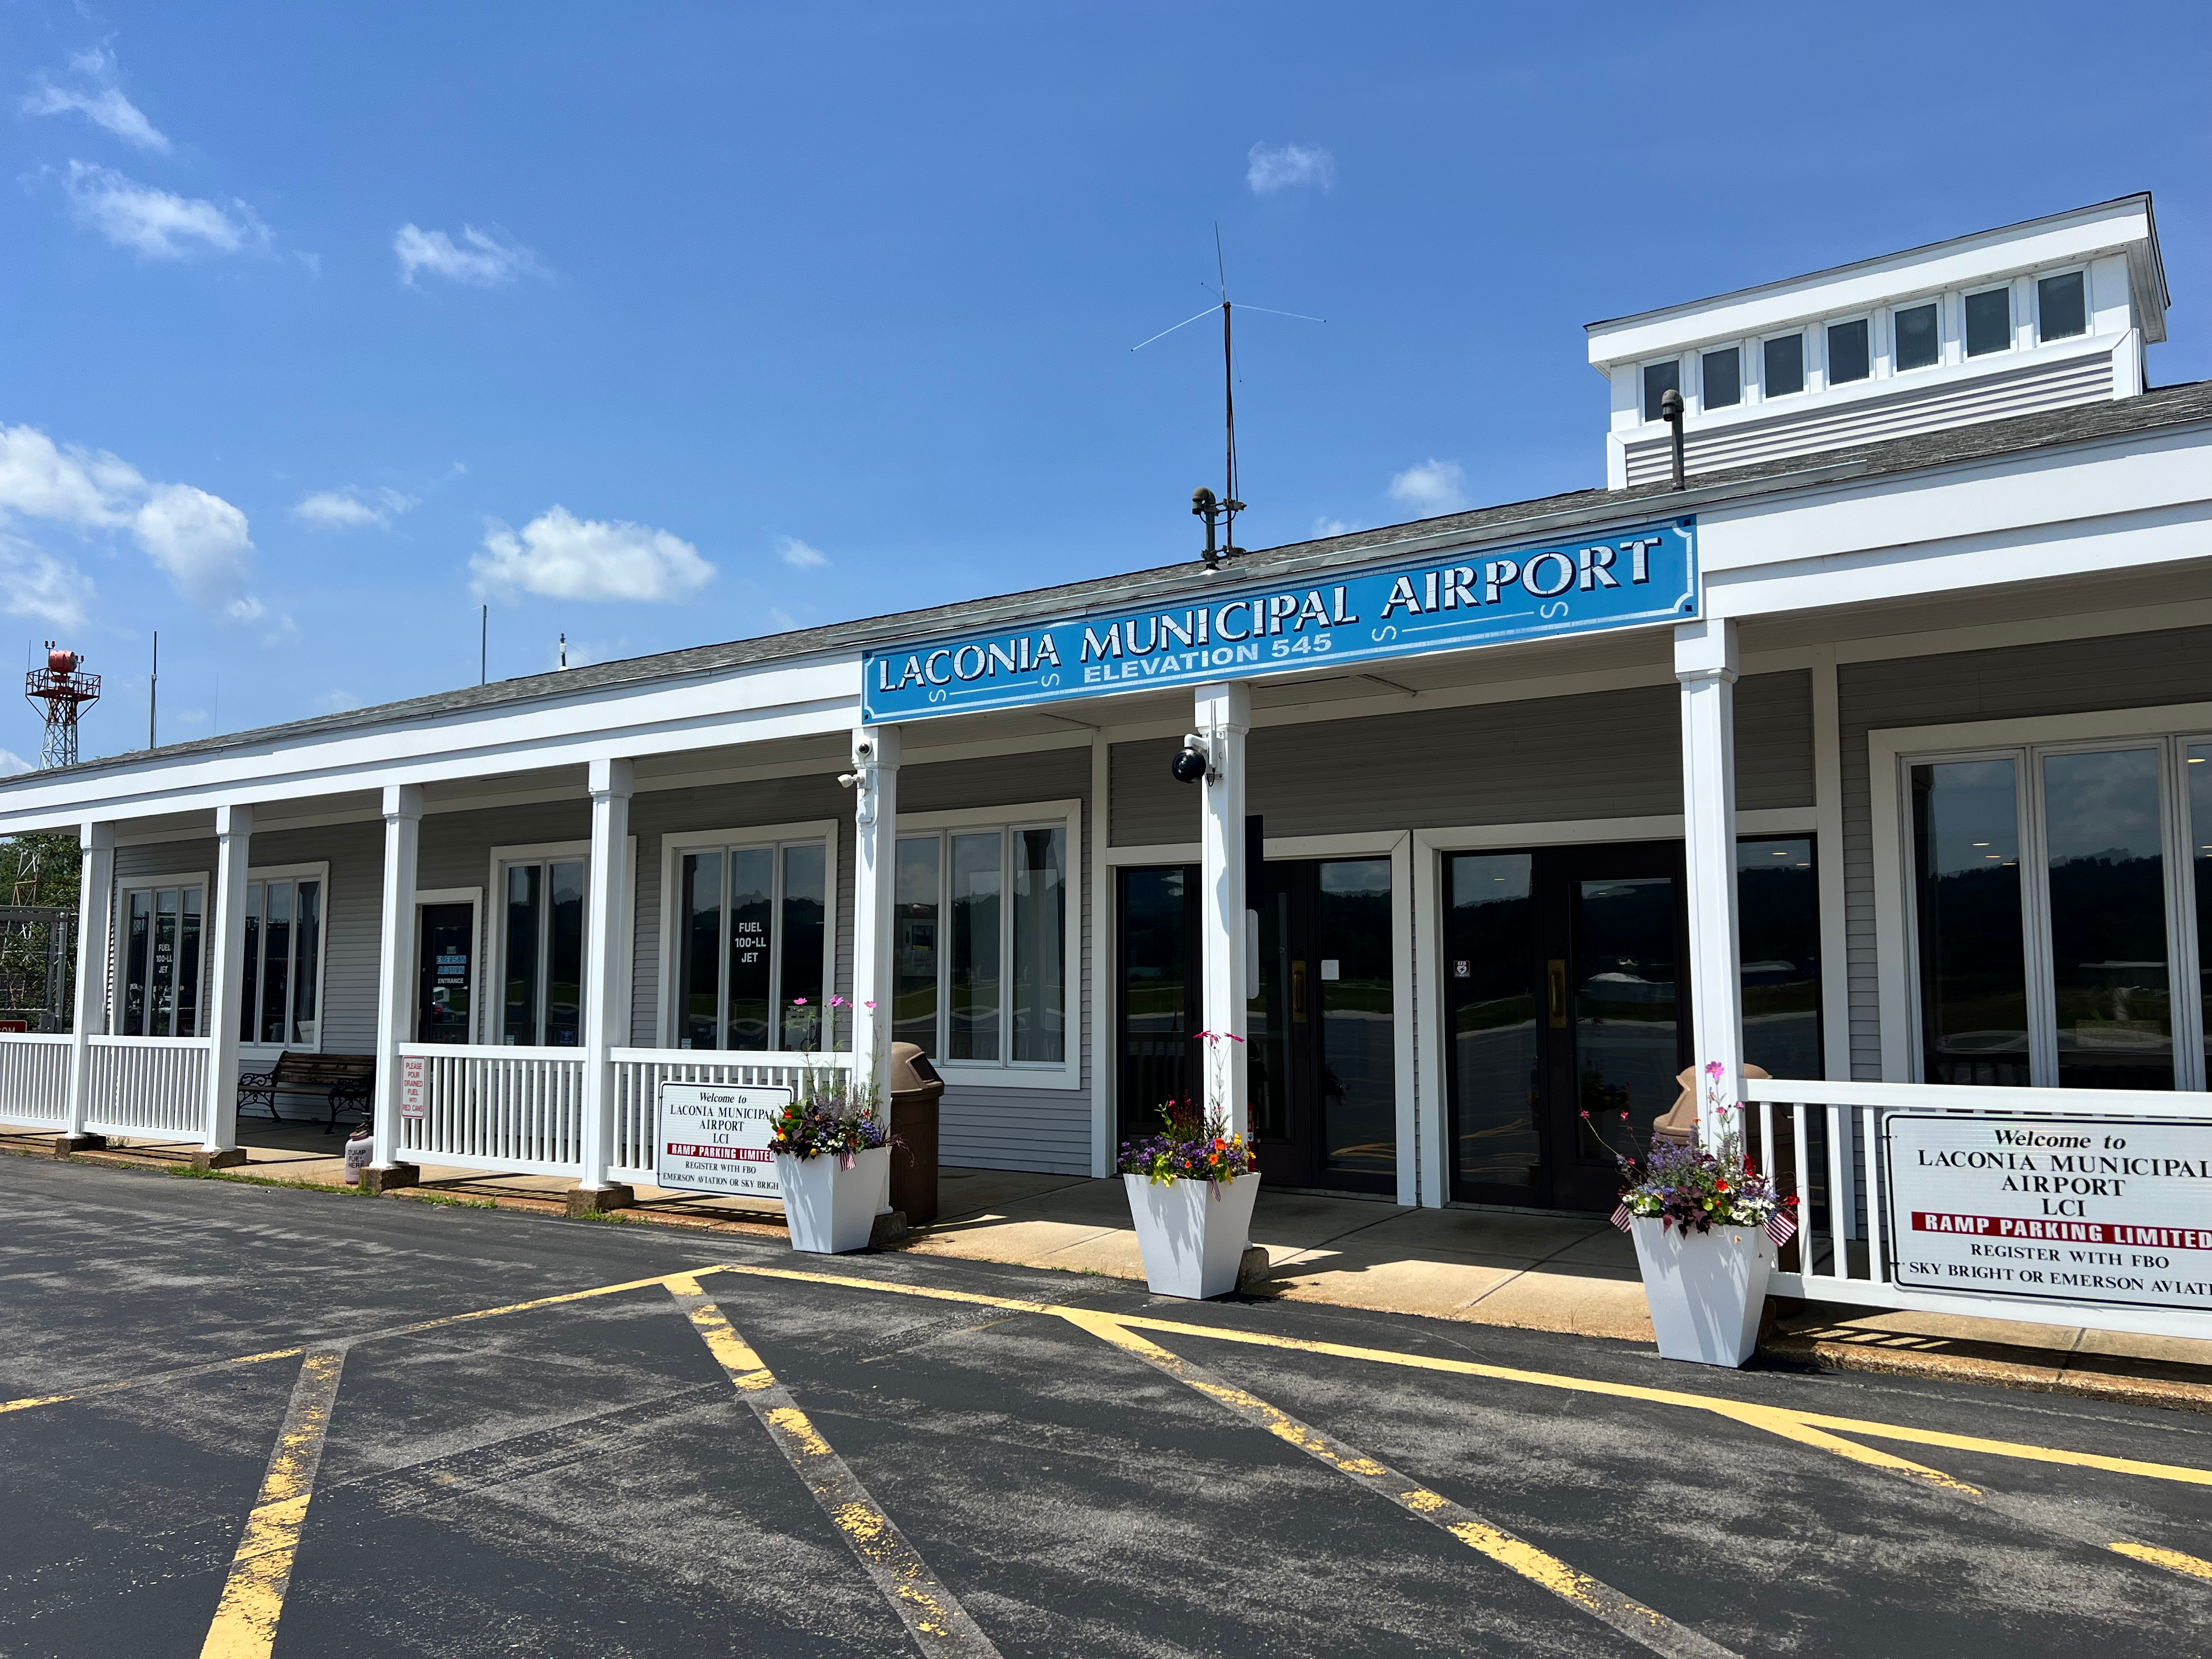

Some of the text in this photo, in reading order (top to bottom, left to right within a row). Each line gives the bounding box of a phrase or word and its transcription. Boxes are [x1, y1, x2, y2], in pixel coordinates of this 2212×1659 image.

[879, 537, 1662, 692] LACONIA MUNICIPAL AIRPORT
[1084, 633, 1332, 684] ELEVATION 545
[739, 922, 762, 932] FUEL
[735, 937, 766, 947] 100-LL
[436, 955, 466, 964] EMERSON
[741, 952, 758, 962] JET
[437, 966, 465, 974] AVIATION
[700, 1092, 747, 1103] Welcome to
[670, 1104, 713, 1116] LACONIA
[699, 1119, 744, 1131] AIRPORT
[713, 1133, 729, 1144] LCI
[1994, 1130, 2126, 1149] Welcome to
[672, 1144, 696, 1155] RAMP
[699, 1146, 736, 1159] PARKING
[685, 1161, 718, 1171] REGISTER
[721, 1164, 740, 1172] WITH
[1918, 1149, 2212, 1178] LACONIA MUNICIPAL
[663, 1172, 695, 1182] EMERSON
[697, 1176, 727, 1185] AVIATION
[741, 1180, 754, 1188] SKY
[758, 1181, 778, 1190] BRIGH
[2001, 1175, 2126, 1196] AIRPORT
[2041, 1198, 2086, 1217] LCI
[1925, 1214, 2212, 1248] RAMP PARKING LIMITED
[1971, 1244, 2170, 1268] REGISTER WITH FBO
[1909, 1262, 1941, 1274] SKY
[1948, 1265, 2014, 1280] BRIGHT
[2020, 1271, 2044, 1283] OR
[2050, 1272, 2144, 1290] EMERSON
